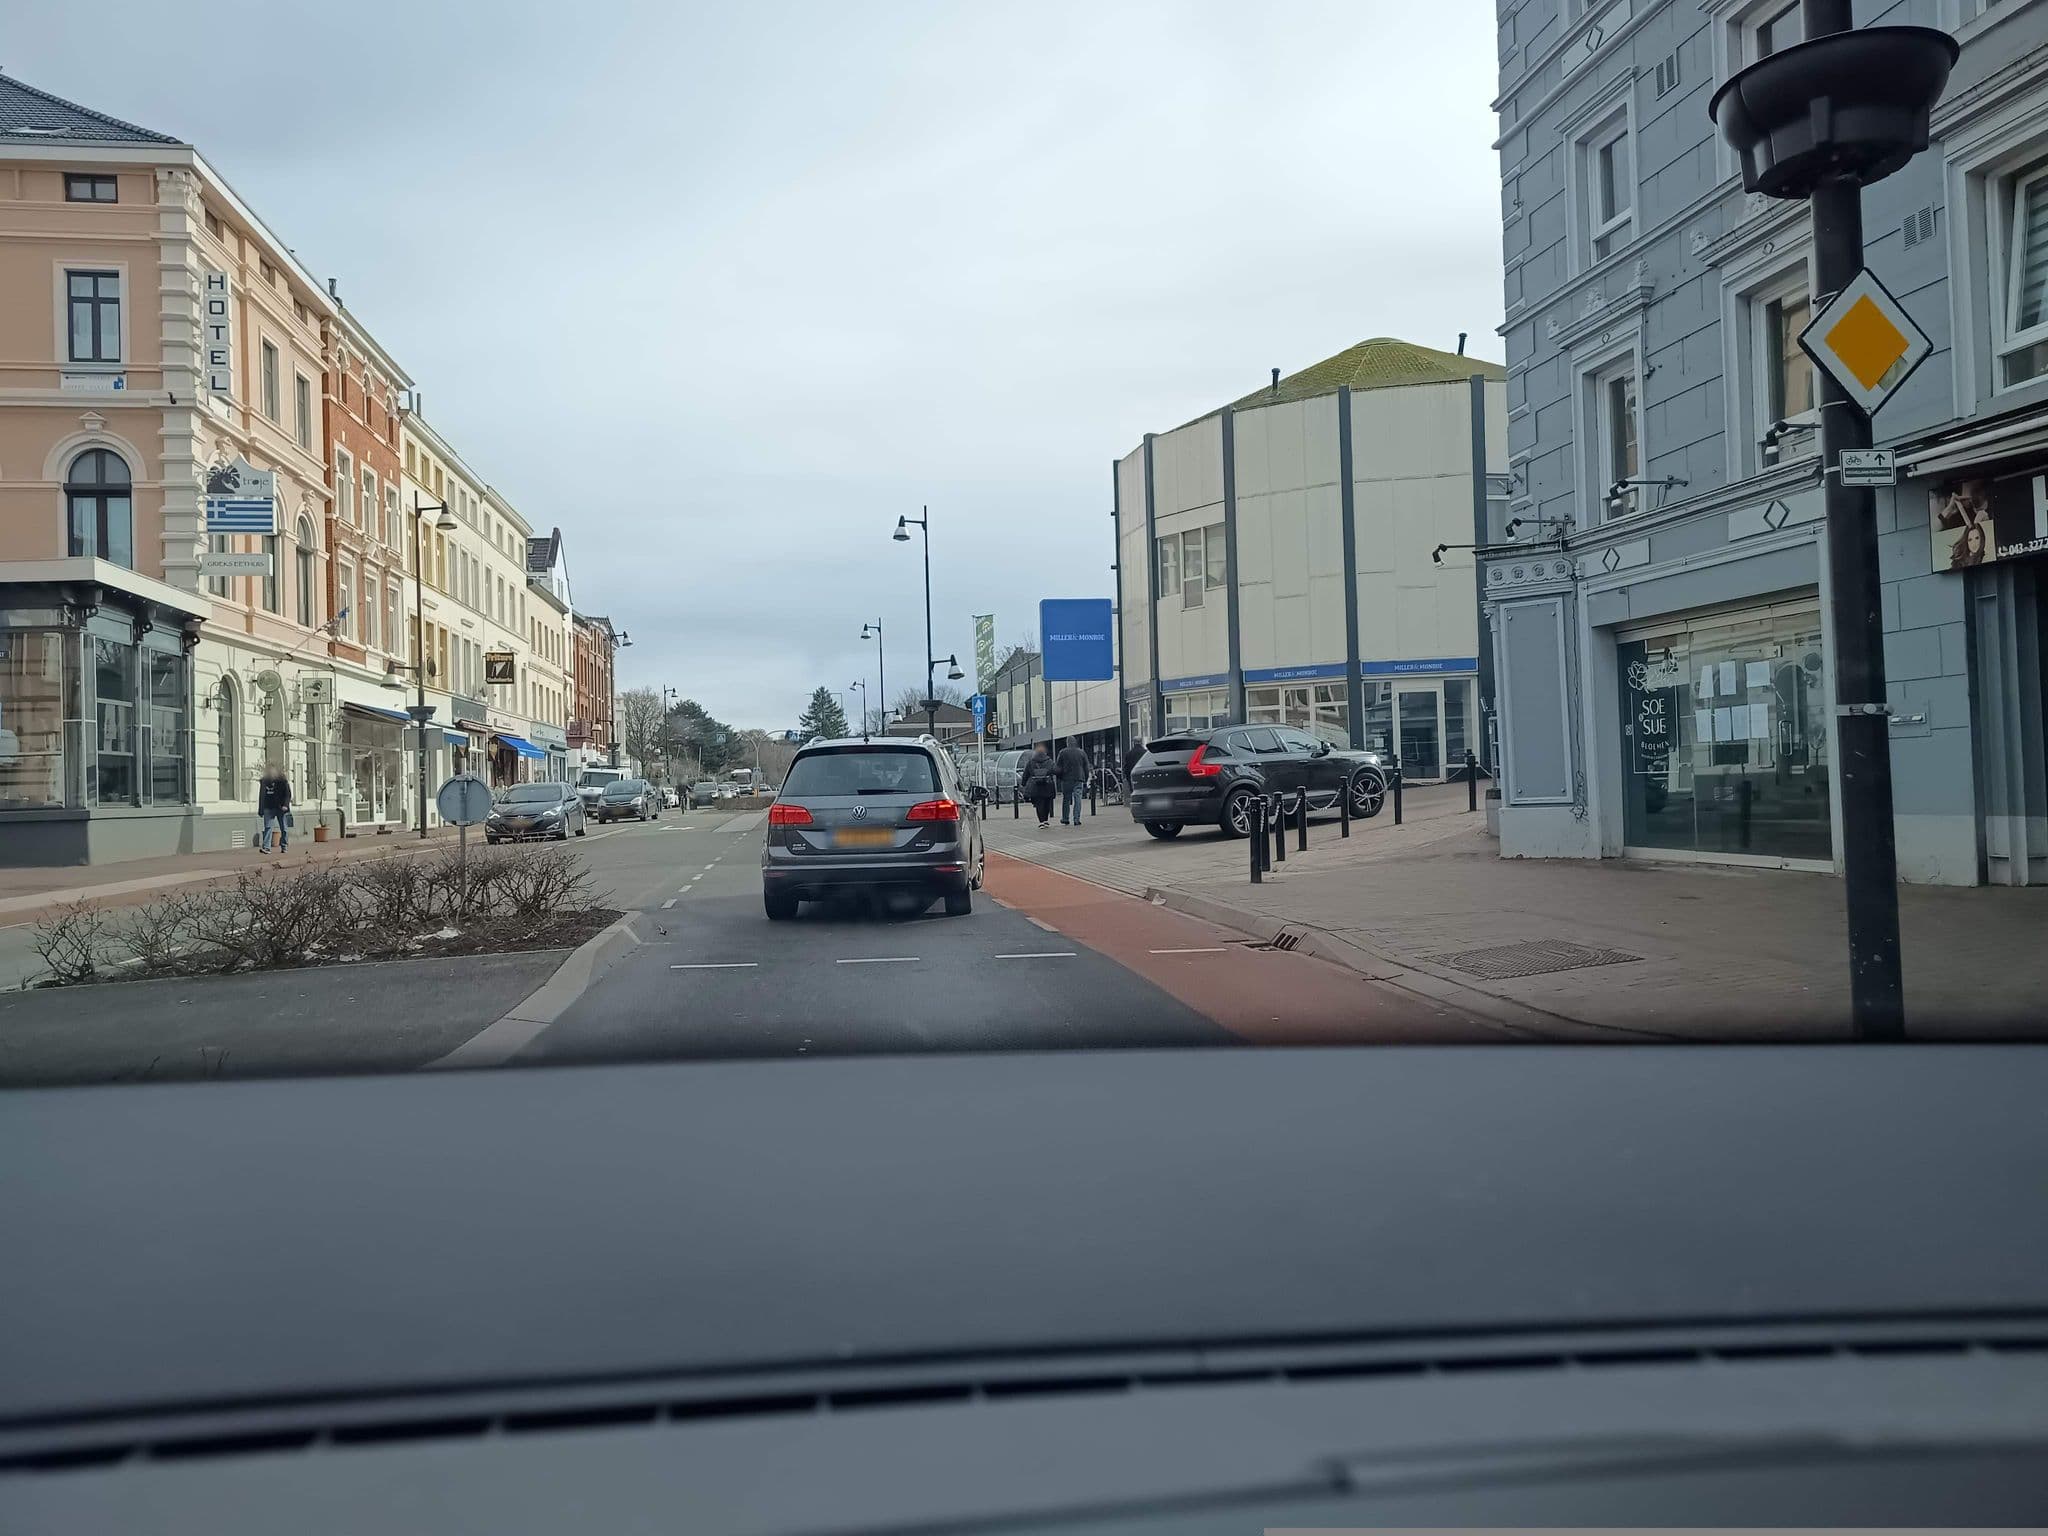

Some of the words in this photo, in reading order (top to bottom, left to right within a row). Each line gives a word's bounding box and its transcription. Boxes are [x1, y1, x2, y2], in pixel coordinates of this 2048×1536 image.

[207, 274, 227, 391] HOTEL
[243, 477, 269, 490] troje
[1642, 698, 1666, 716] SOE
[1643, 718, 1667, 735] SUE
